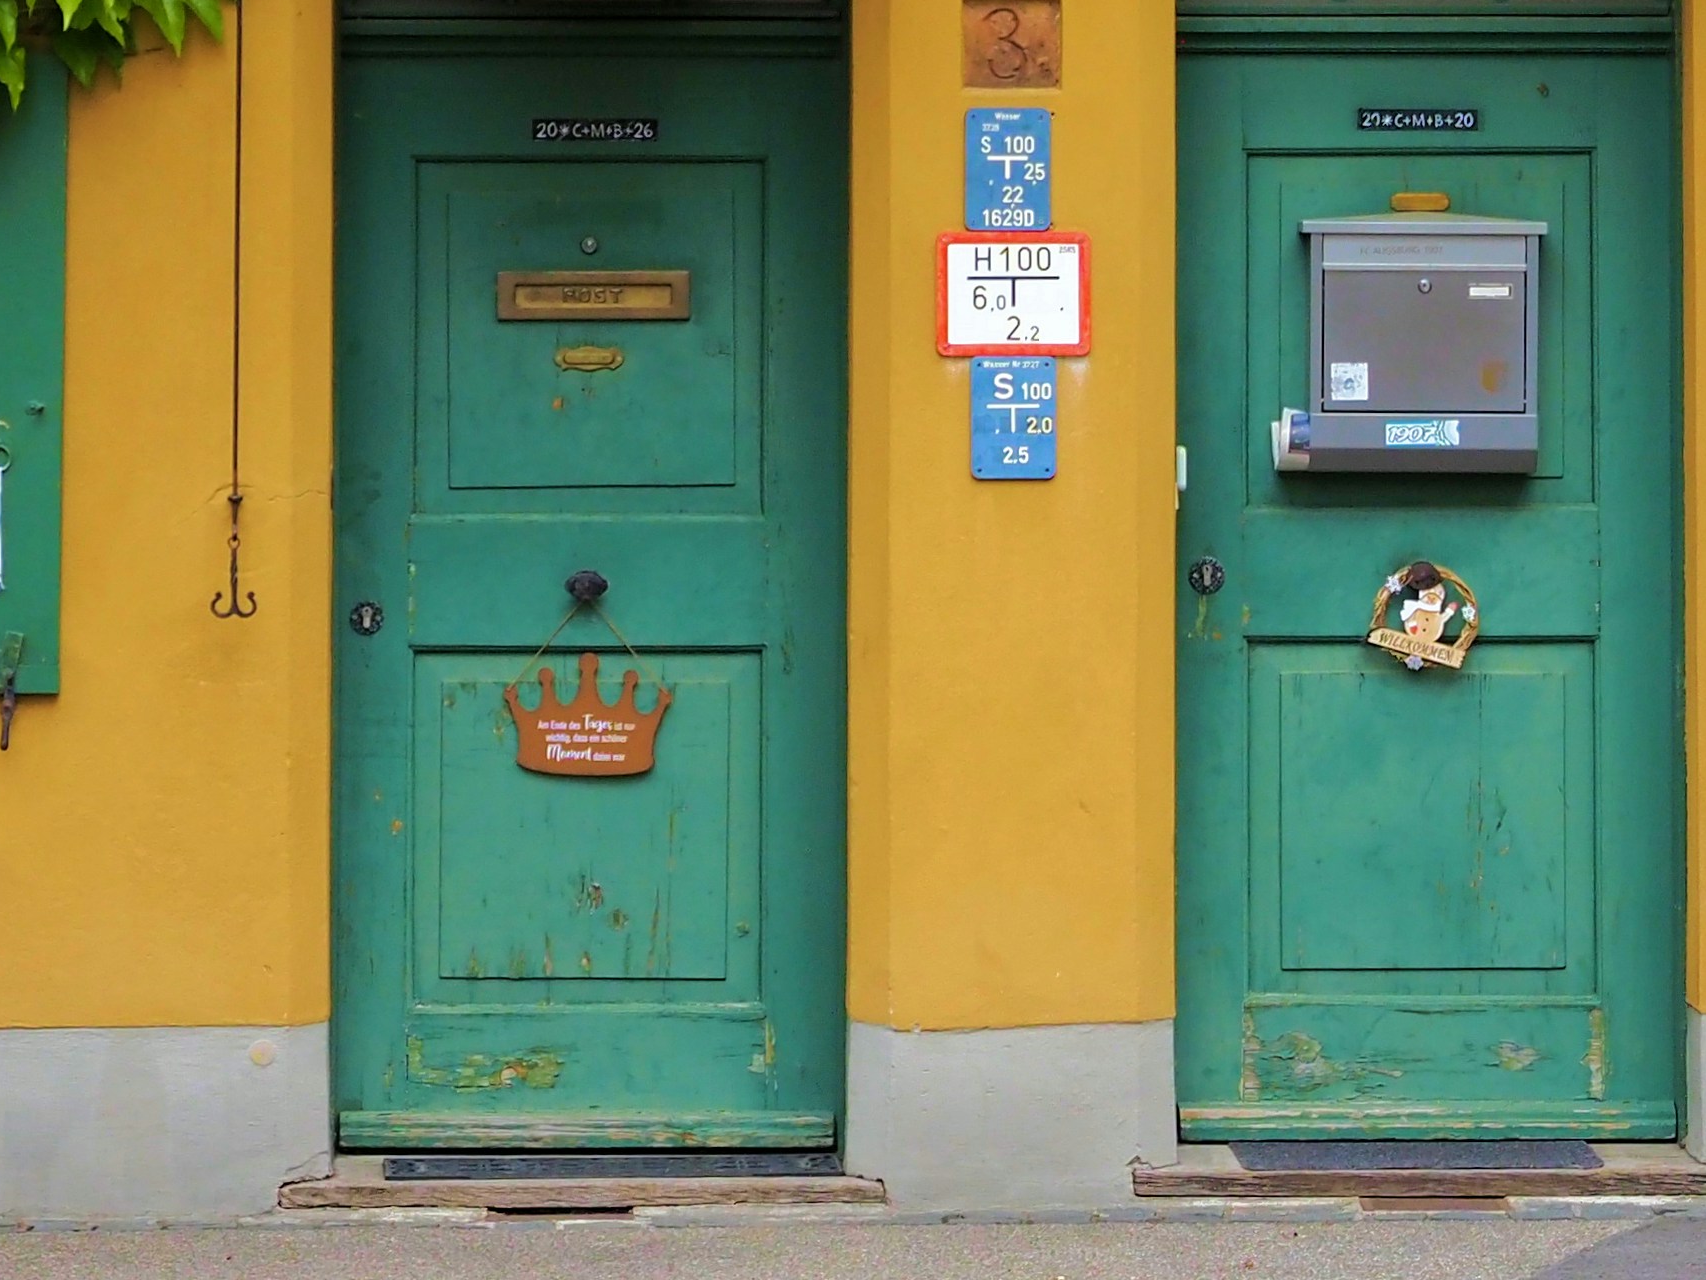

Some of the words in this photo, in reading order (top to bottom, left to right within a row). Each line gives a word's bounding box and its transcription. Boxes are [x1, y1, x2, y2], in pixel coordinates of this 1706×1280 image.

[982, 8, 1027, 79] 3
[981, 136, 991, 154] S
[1004, 136, 1035, 154] 100
[561, 287, 623, 304] POST
[994, 372, 1013, 400] S
[1021, 382, 1052, 400] 100
[1388, 425, 1438, 443] 1907
[1379, 633, 1455, 663] WILLKOMMEN
[582, 713, 612, 733] Tages
[547, 743, 591, 762] Moment
